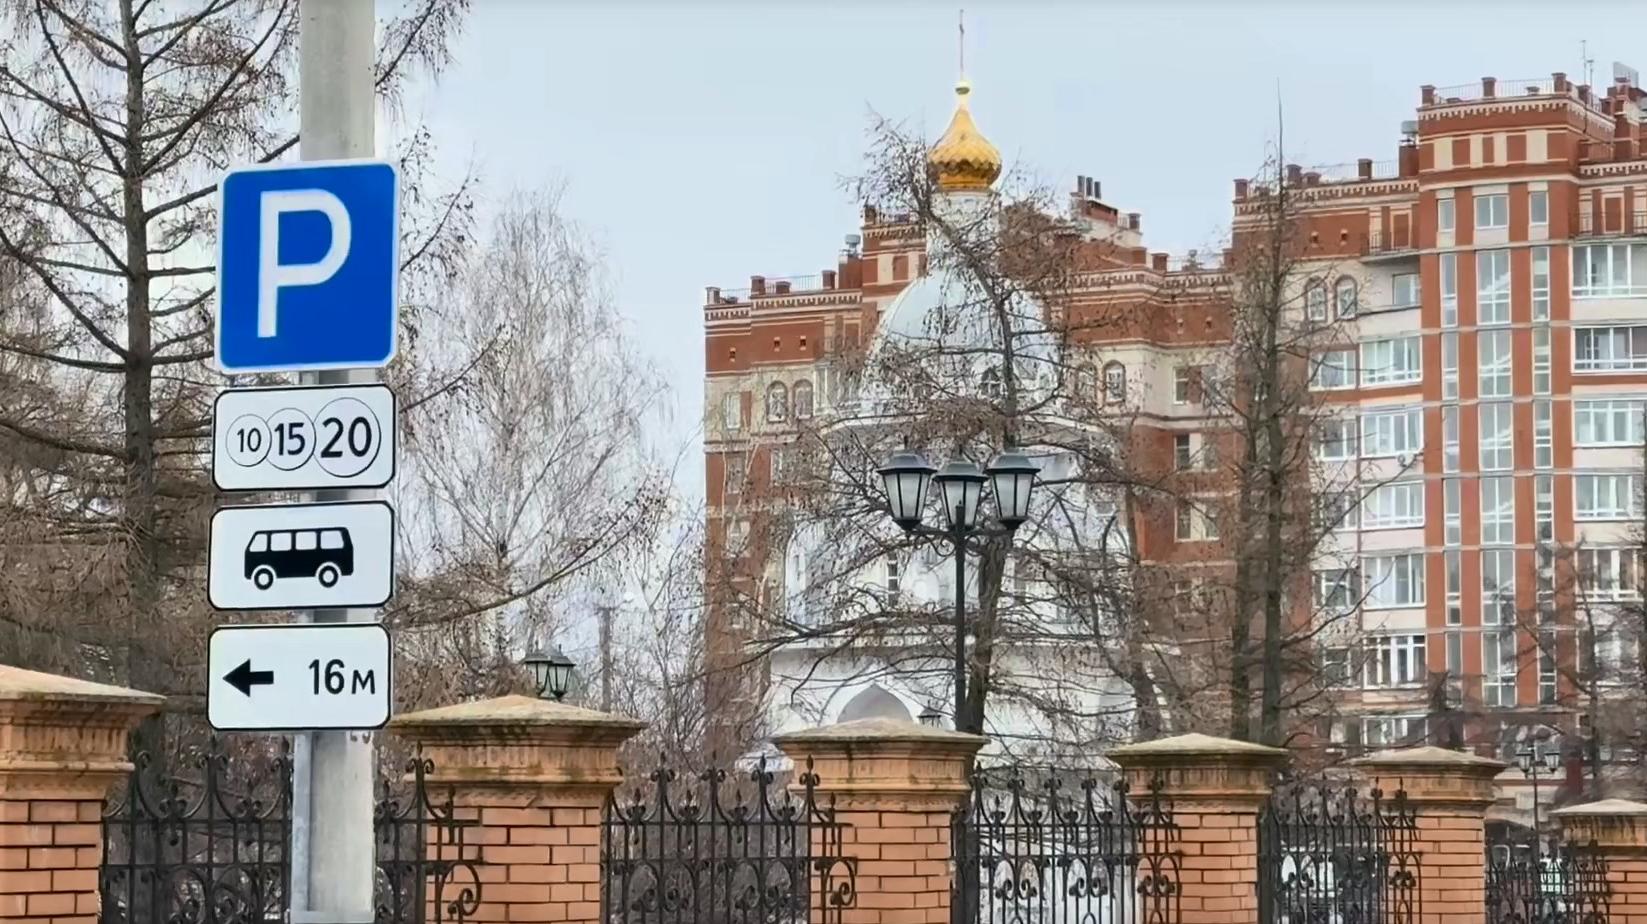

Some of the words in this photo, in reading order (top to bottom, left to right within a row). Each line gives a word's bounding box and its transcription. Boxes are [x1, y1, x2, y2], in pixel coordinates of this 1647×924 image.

[258, 189, 352, 338] P
[237, 428, 262, 453] 10
[274, 423, 306, 456] 15
[320, 417, 373, 458] 20
